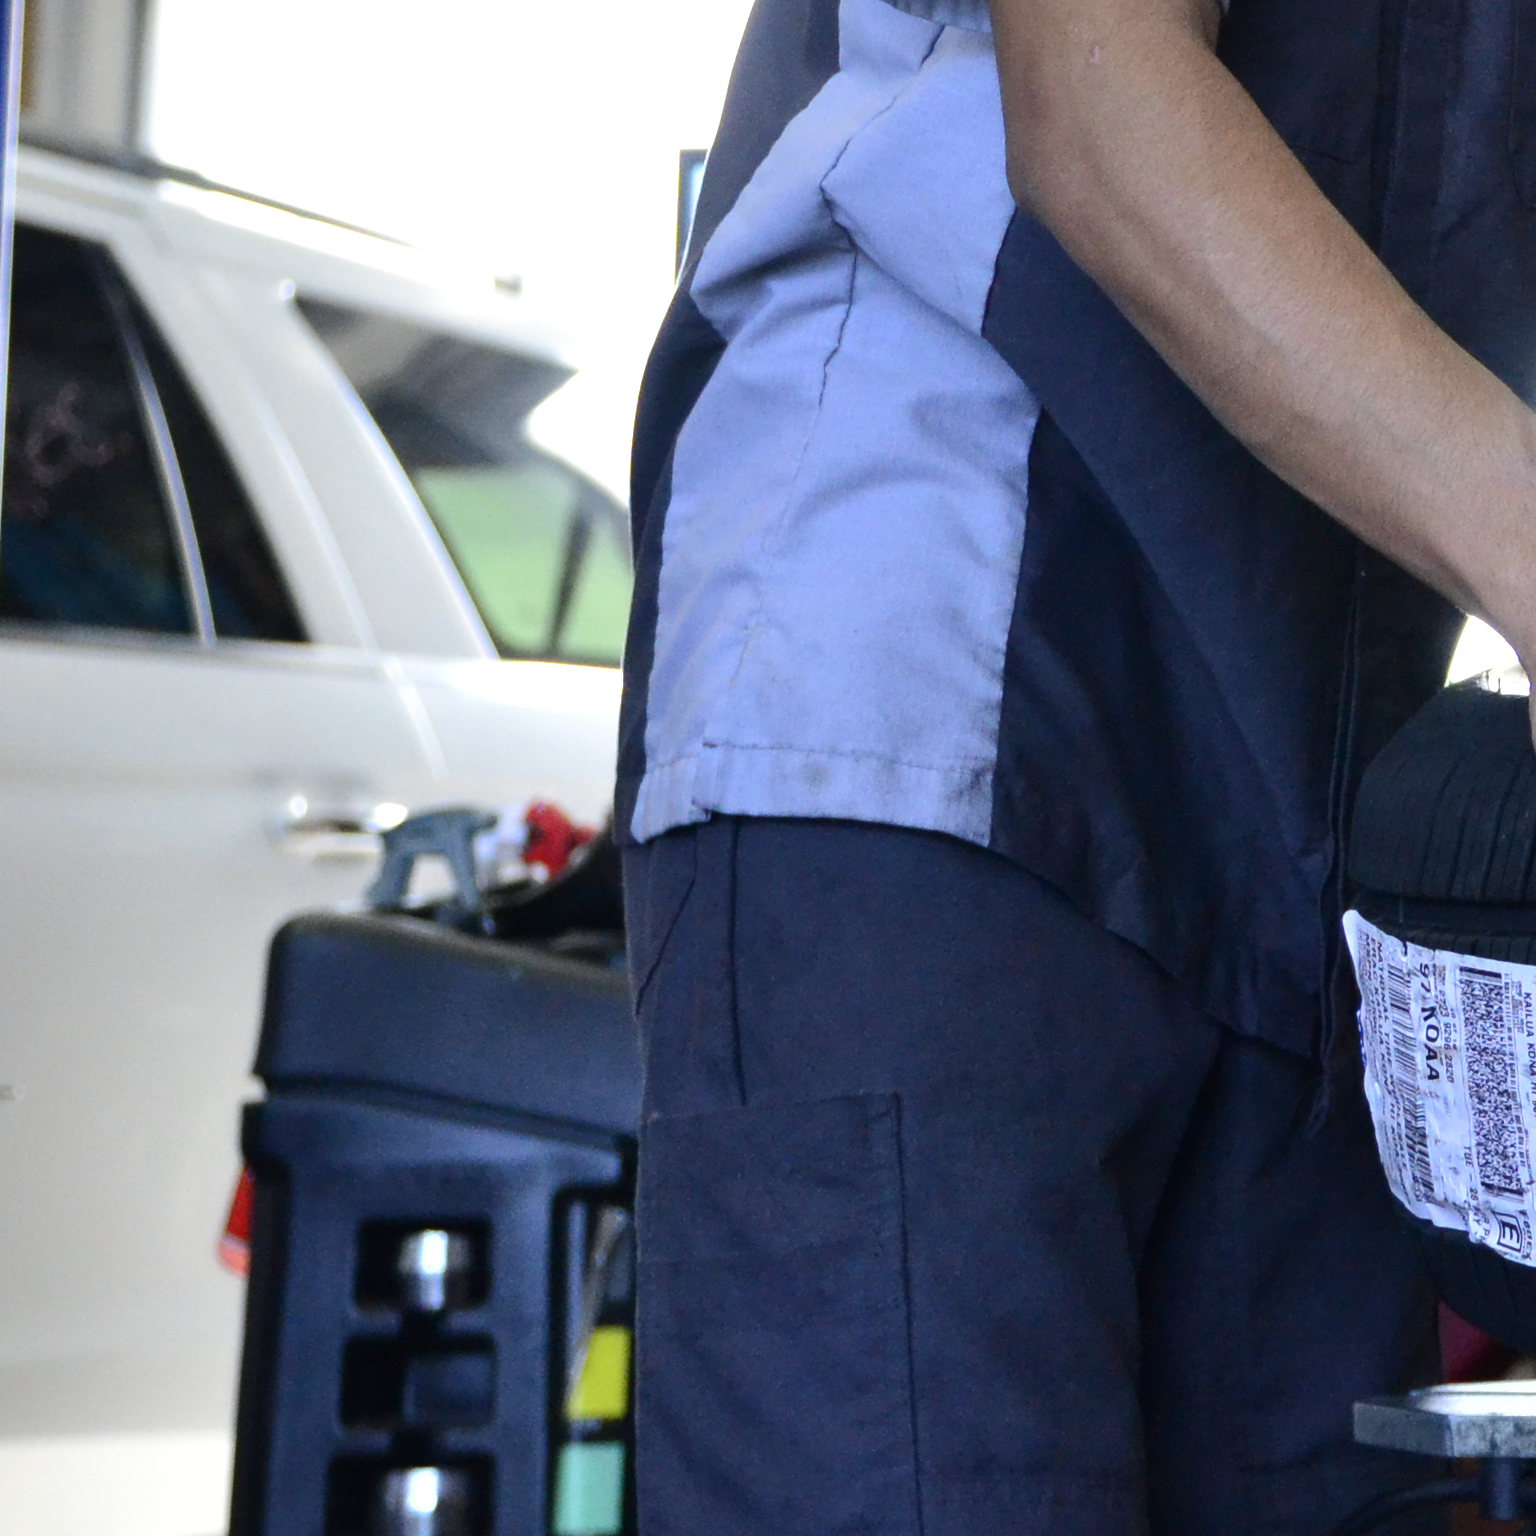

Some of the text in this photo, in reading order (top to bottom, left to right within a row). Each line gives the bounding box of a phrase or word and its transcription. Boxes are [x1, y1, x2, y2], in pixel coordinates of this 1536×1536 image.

[1376, 941, 1390, 1021] NATIONAL
[1420, 962, 1432, 993] 97
[1523, 992, 1535, 1038] KAILUA
[1420, 1006, 1440, 1081] KOAA
[1444, 1055, 1455, 1083] 2820
[1464, 1146, 1473, 1167] TUE
[1469, 1188, 1479, 1201] 26
[1500, 1220, 1520, 1244] E
